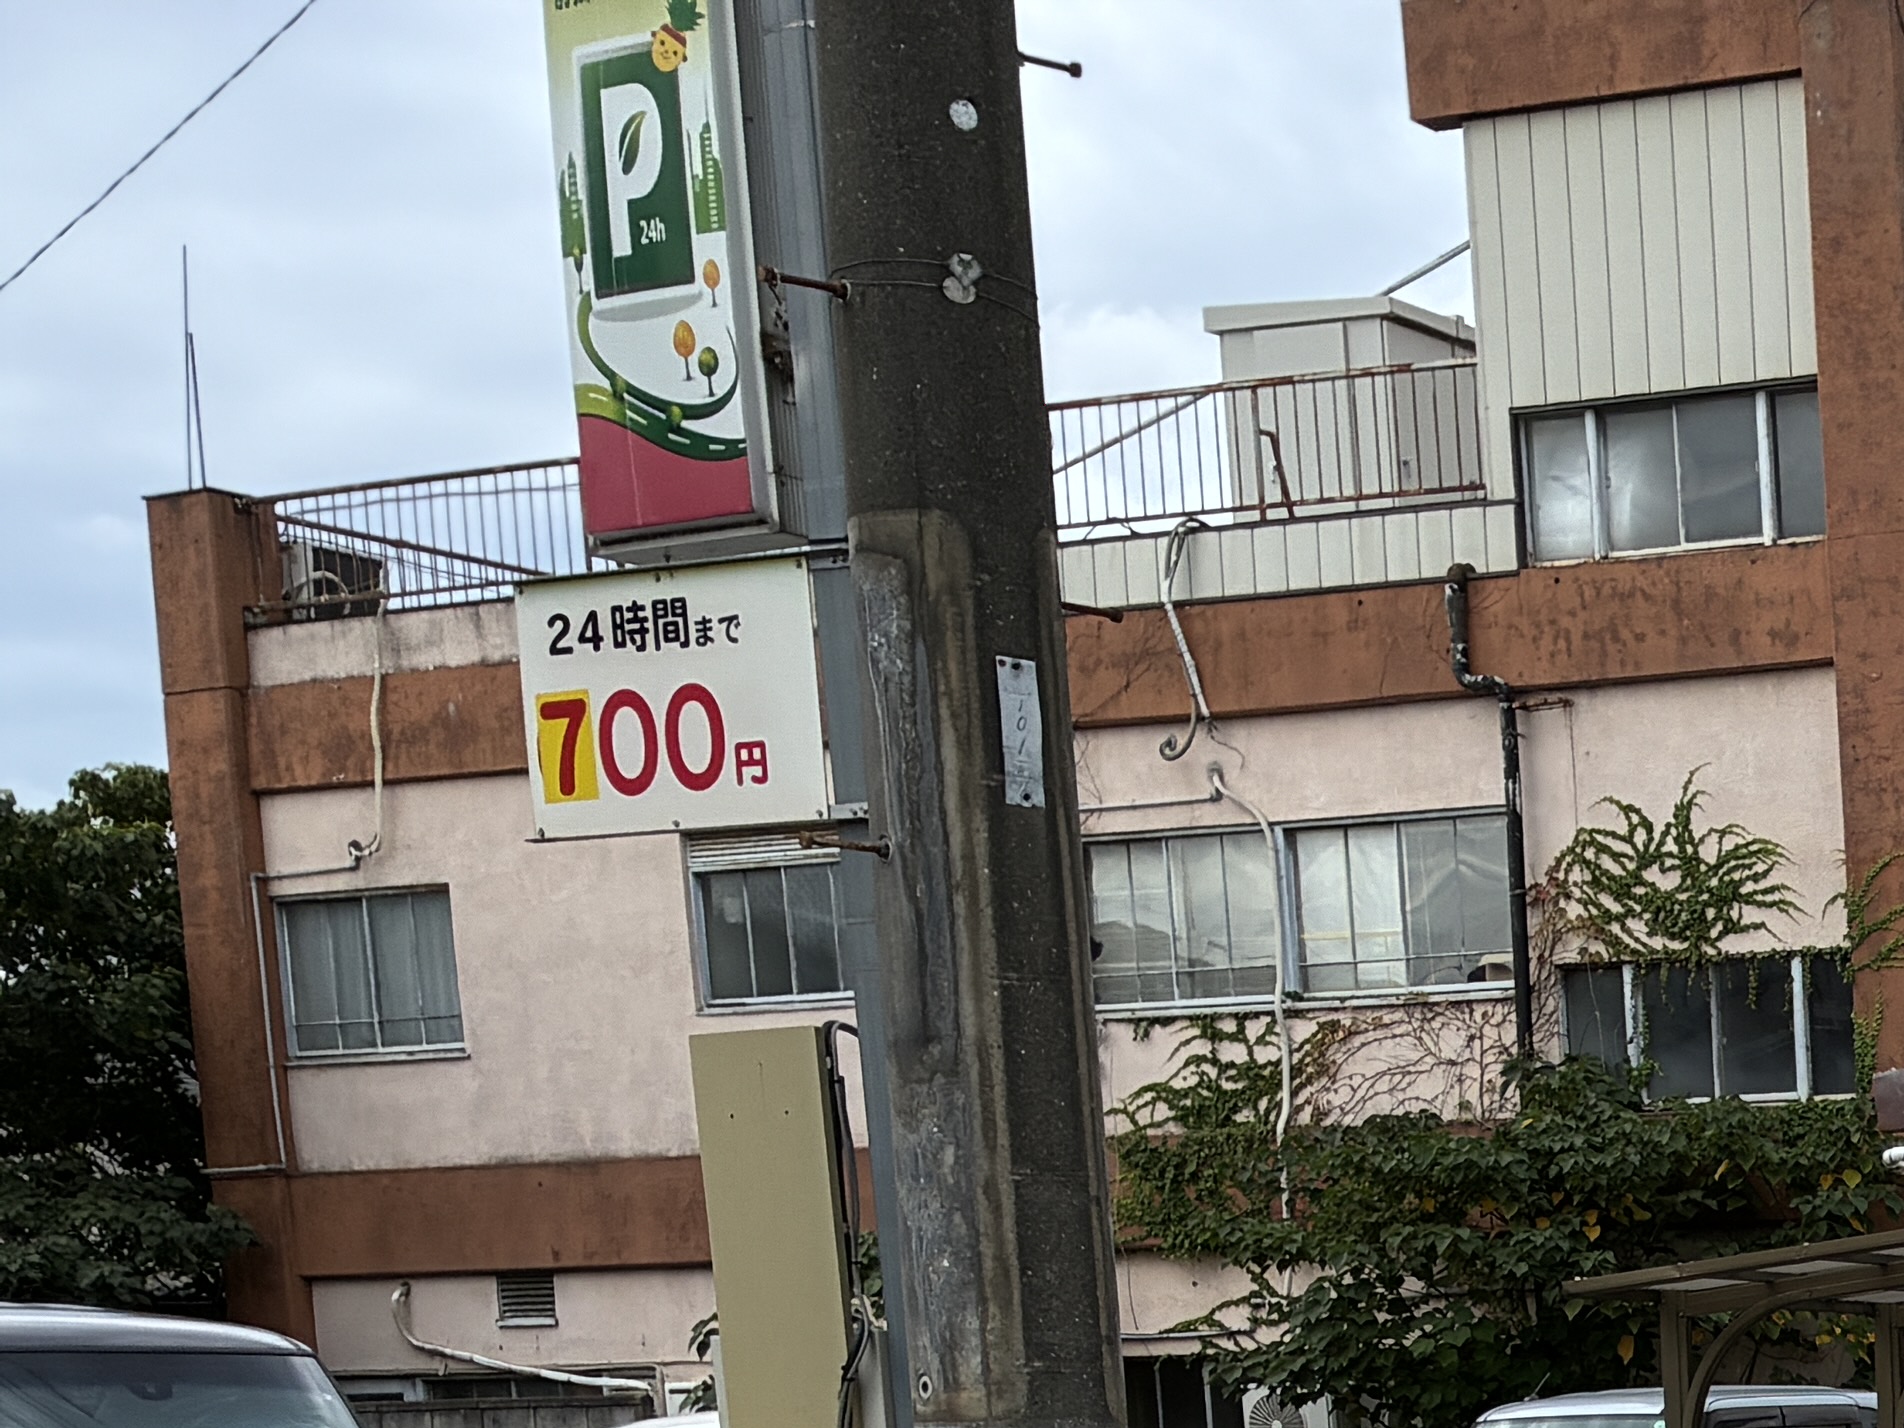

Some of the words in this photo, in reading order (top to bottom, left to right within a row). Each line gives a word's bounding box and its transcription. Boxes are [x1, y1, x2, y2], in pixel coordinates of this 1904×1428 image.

[639, 216, 666, 245] 24h
[546, 596, 742, 657] 24時間まで
[537, 681, 770, 799] 700円
